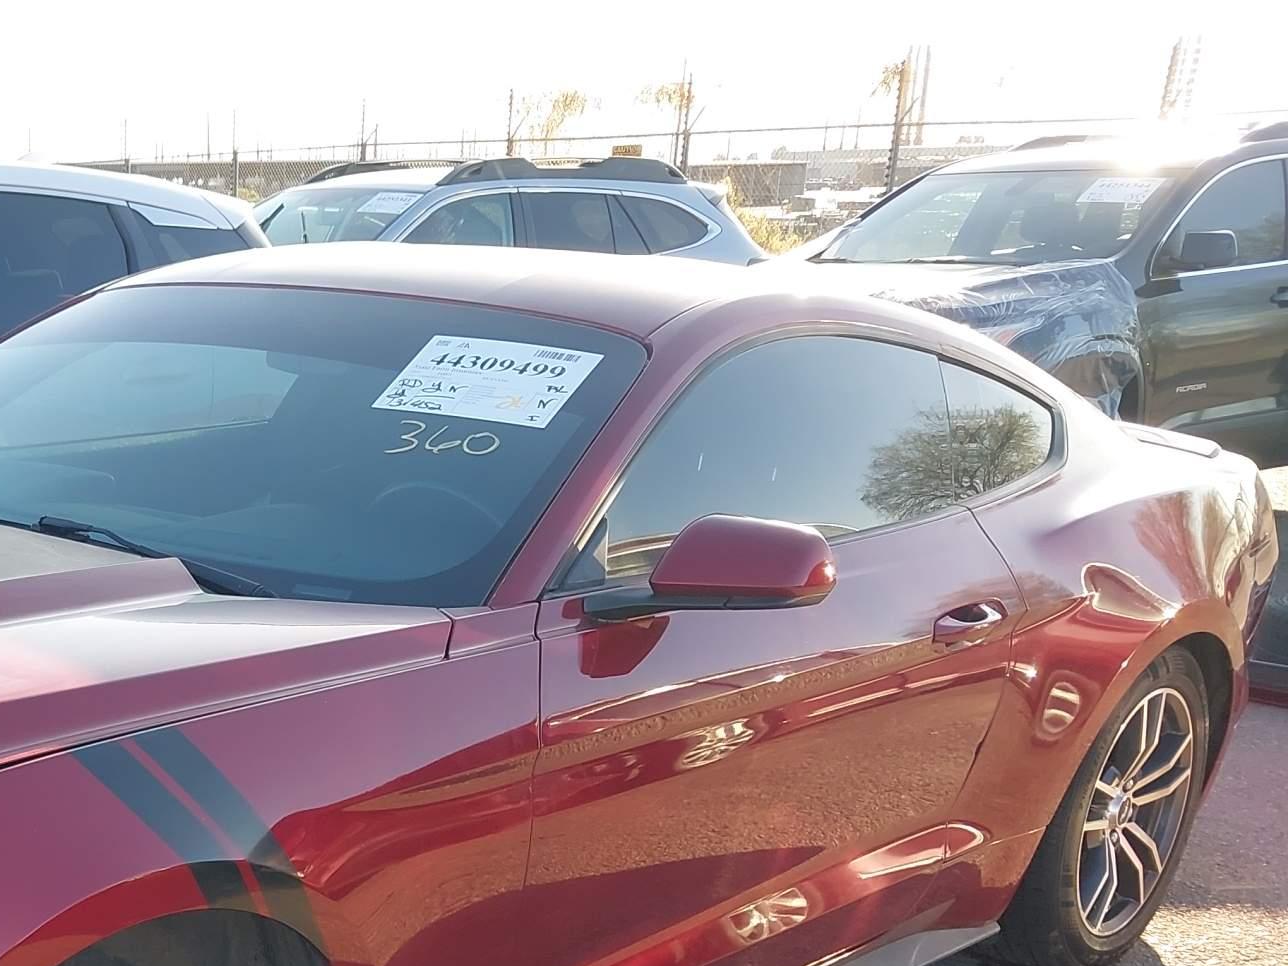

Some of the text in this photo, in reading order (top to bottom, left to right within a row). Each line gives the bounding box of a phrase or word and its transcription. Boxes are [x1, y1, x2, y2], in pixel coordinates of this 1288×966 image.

[430, 352, 567, 379] 44309499
[1175, 383, 1207, 392] ACADIA
[384, 420, 500, 455] 360
